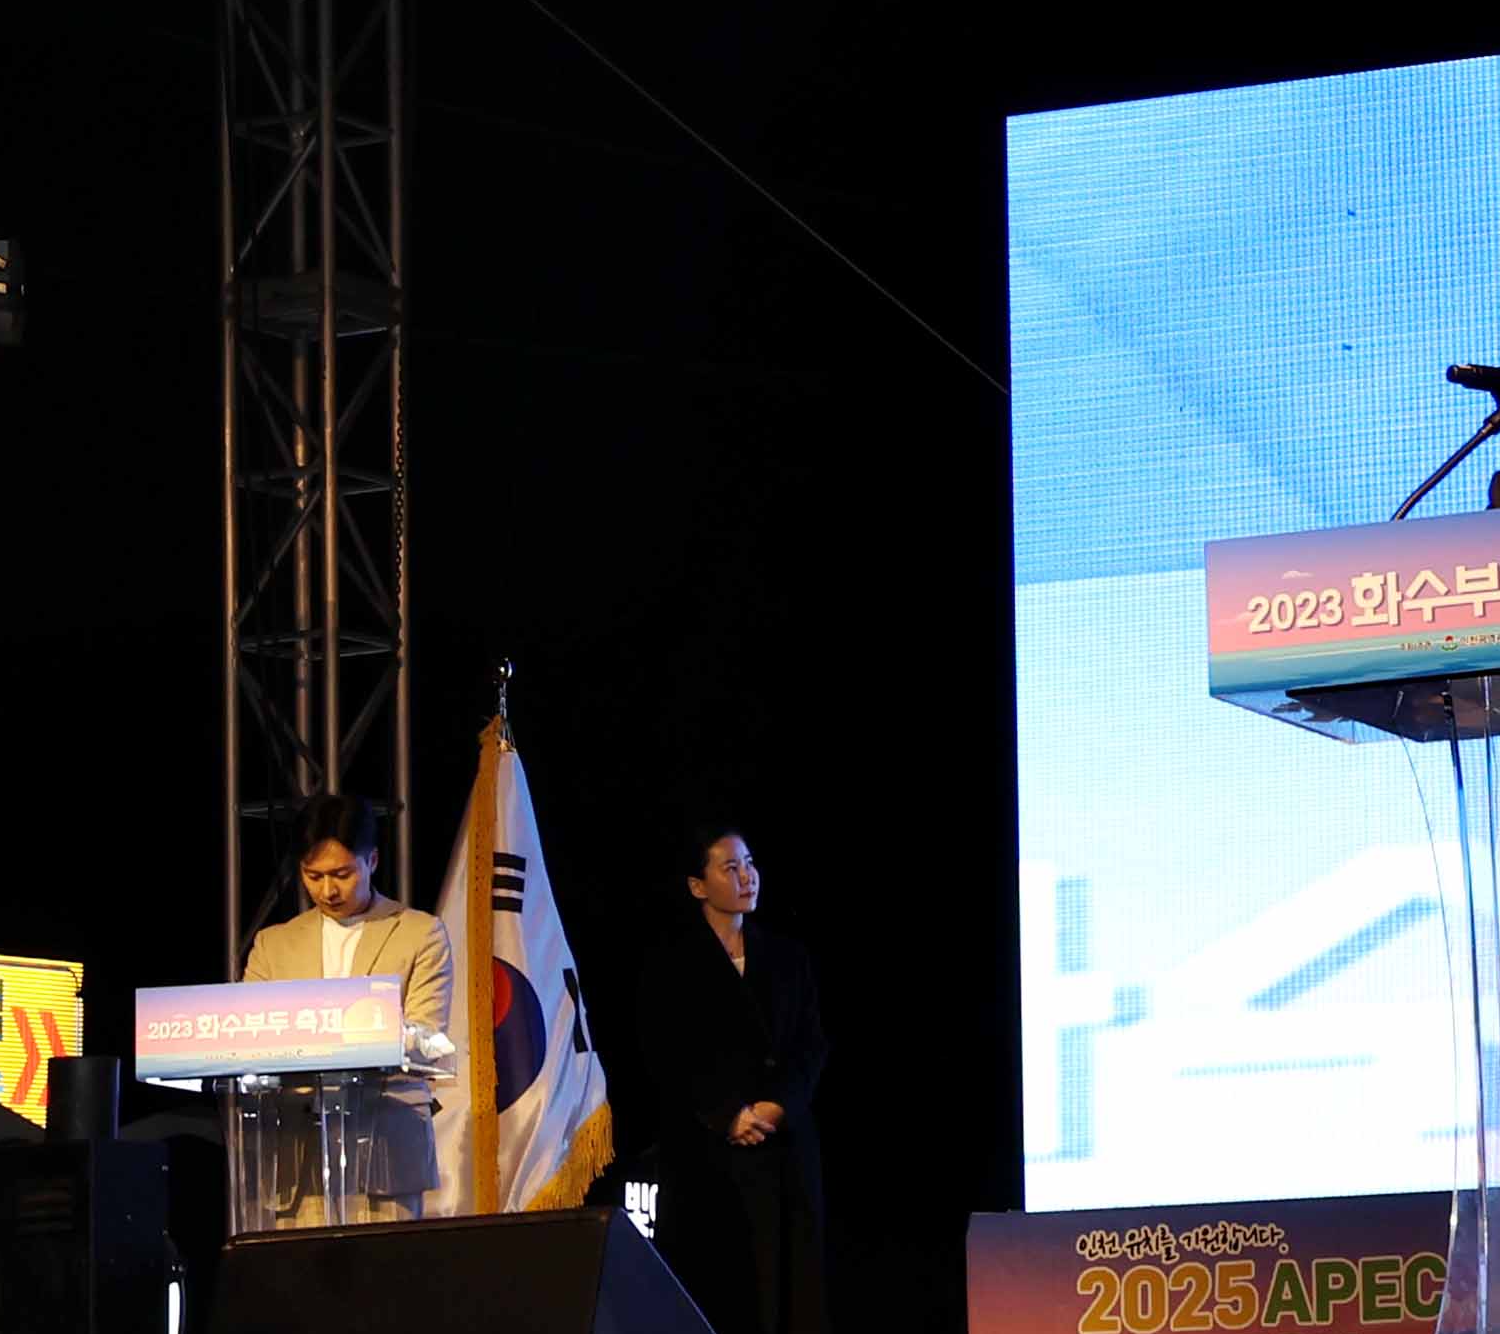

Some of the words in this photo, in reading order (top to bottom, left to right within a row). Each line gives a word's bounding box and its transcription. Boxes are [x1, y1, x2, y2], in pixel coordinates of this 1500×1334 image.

[1247, 588, 1344, 634] 2023
[147, 1020, 192, 1039] 2023
[196, 1010, 289, 1039] 화수부두
[1077, 1227, 1120, 1260] 인천
[1124, 1224, 1180, 1265] 유치를
